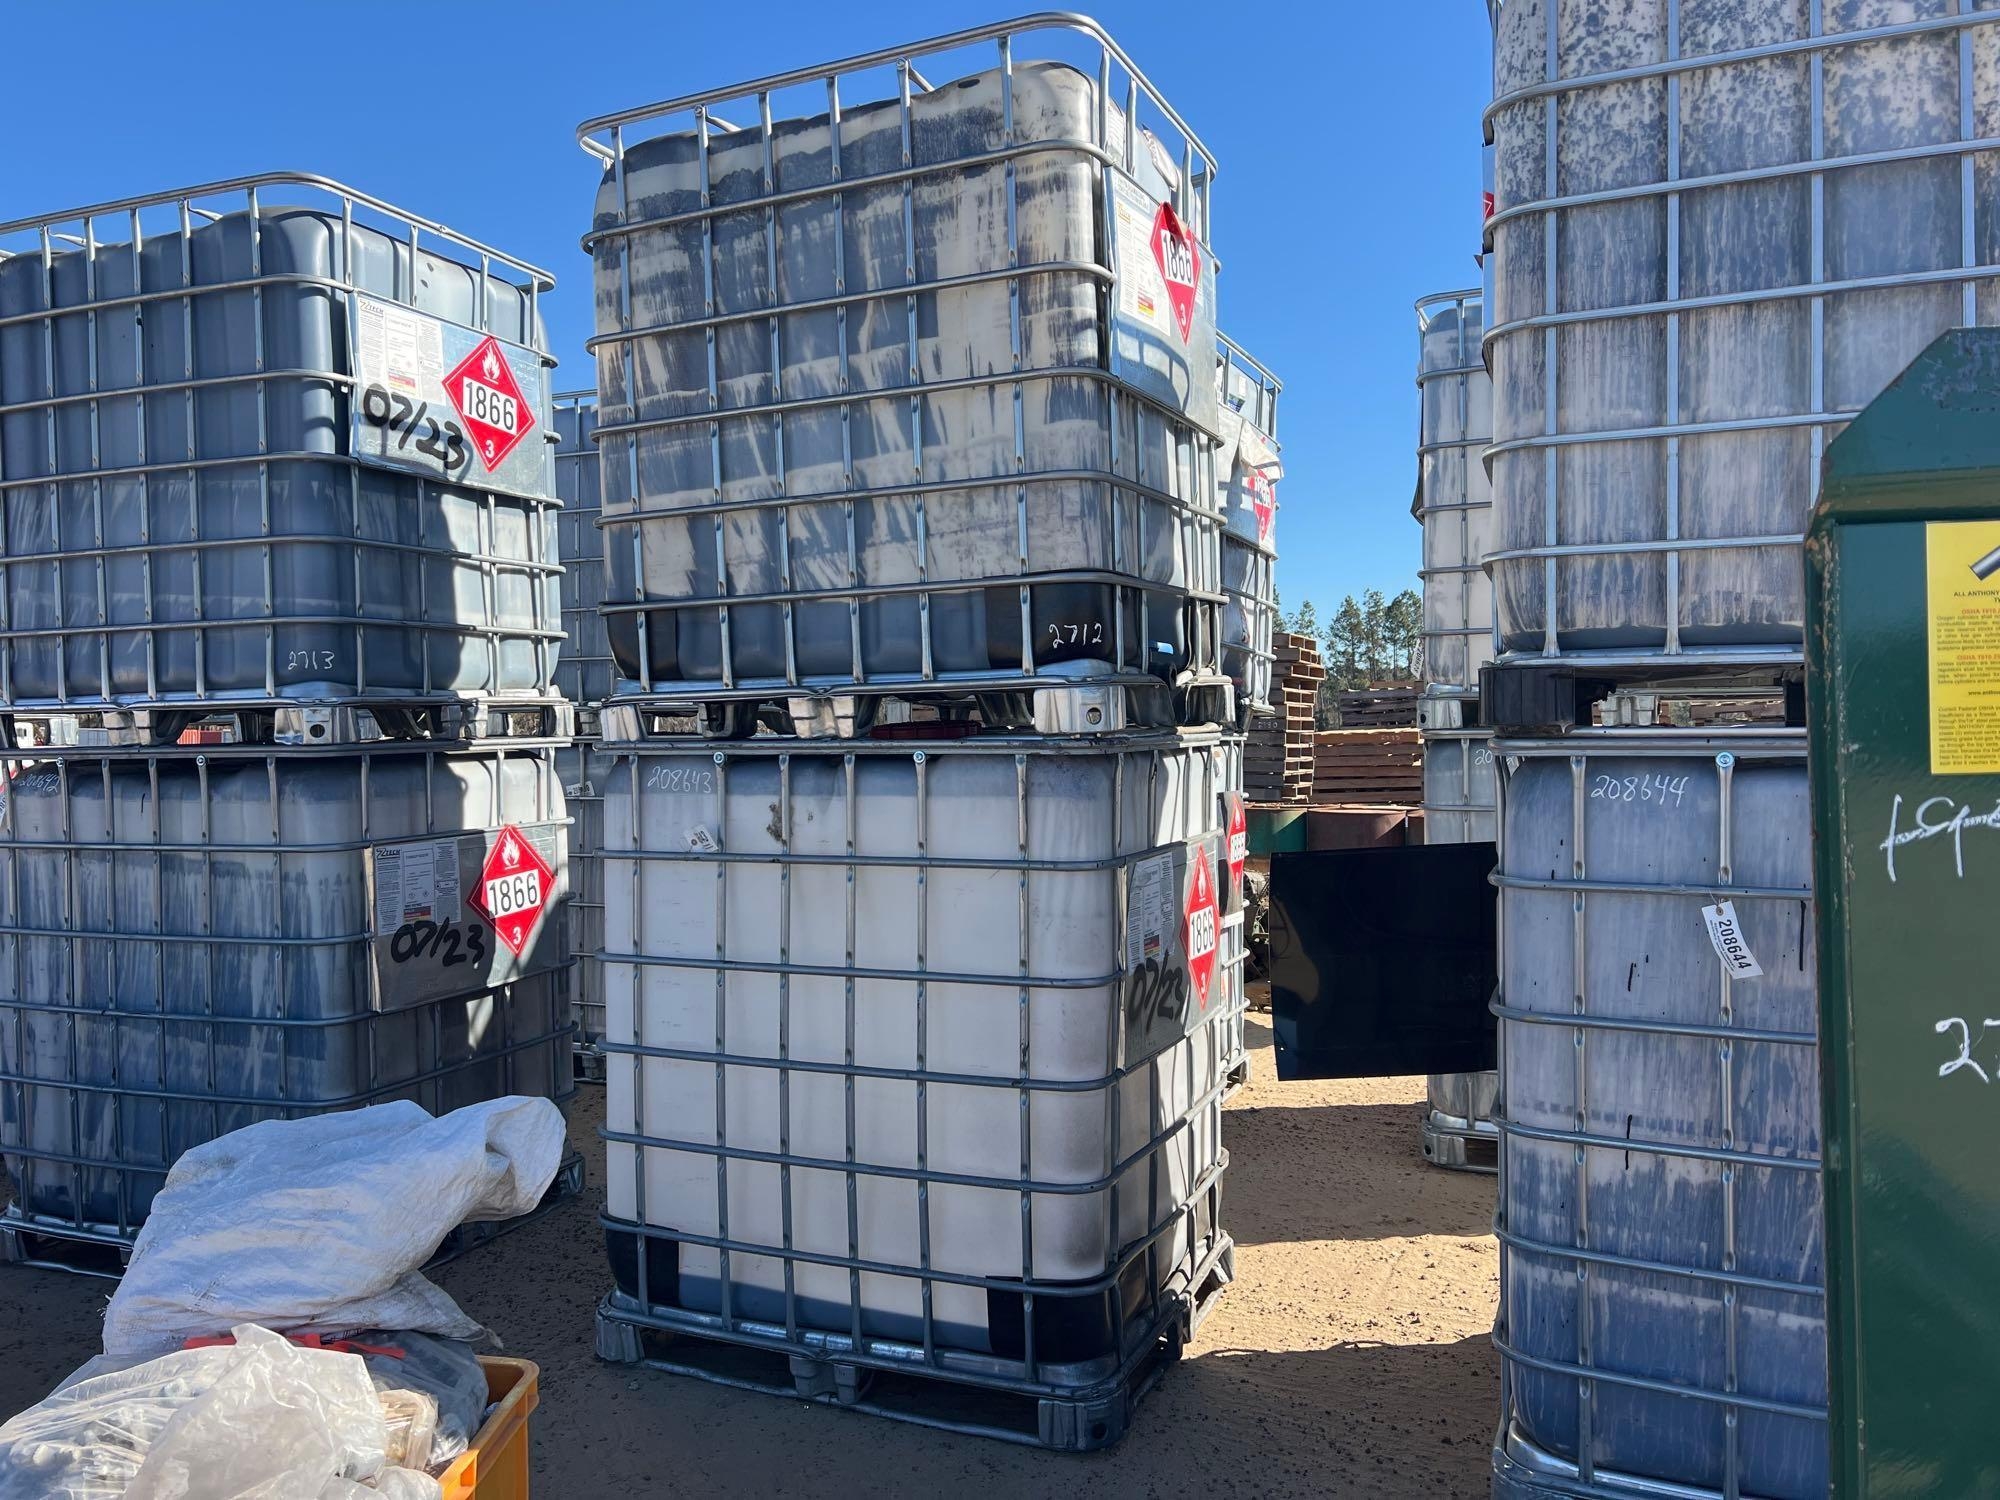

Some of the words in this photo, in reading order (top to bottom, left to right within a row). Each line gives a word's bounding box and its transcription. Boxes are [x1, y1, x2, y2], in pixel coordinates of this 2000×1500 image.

[1179, 303, 1187, 326] 3
[465, 381, 515, 431] 1866
[363, 383, 466, 470] 07/23
[485, 440, 495, 459] 3
[1048, 622, 1102, 649] 2712
[287, 650, 335, 670] 2713
[647, 765, 712, 793] 208643
[1590, 774, 1690, 808] 208644
[488, 872, 538, 916] 1866
[390, 916, 486, 967] 07/23
[512, 926, 522, 945] 3
[1190, 910, 1215, 957] 1866
[1718, 919, 1753, 969] 208644
[1128, 949, 1185, 1033] 07/23
[1200, 973, 1206, 995] 3
